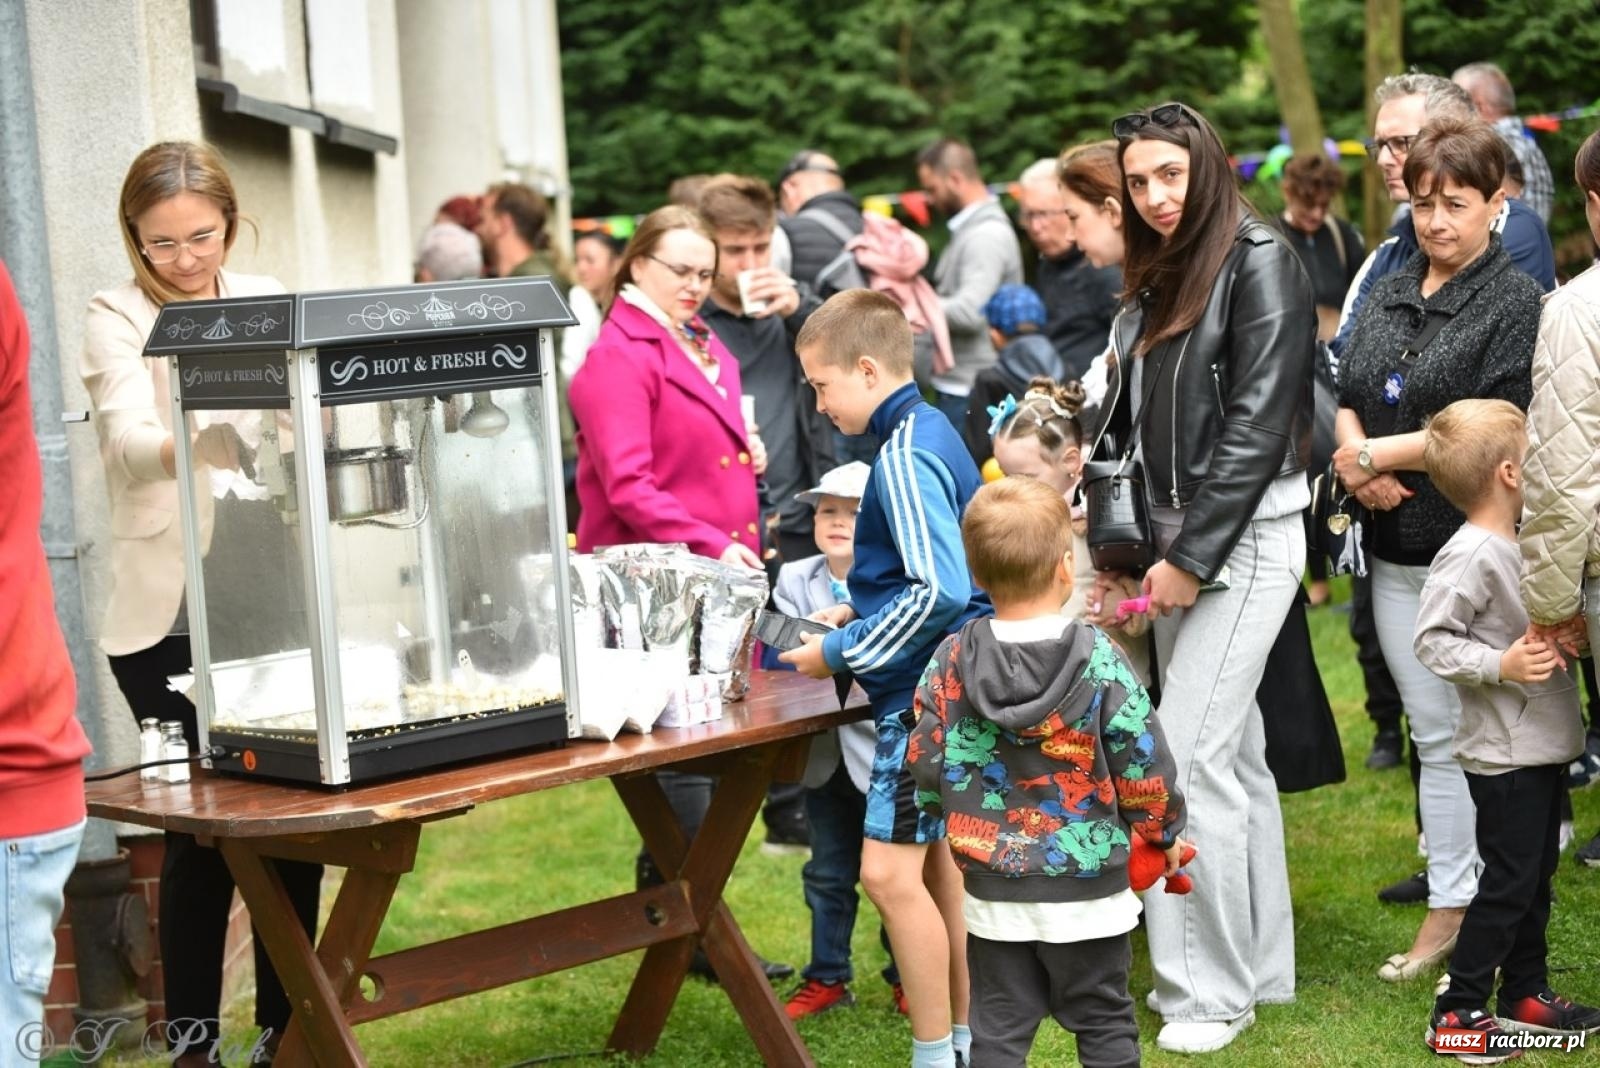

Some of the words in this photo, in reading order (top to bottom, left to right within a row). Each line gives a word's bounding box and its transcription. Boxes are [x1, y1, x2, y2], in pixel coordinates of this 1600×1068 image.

[373, 357, 410, 376] HOT
[414, 355, 428, 372] &
[431, 351, 487, 370] FRESH
[204, 371, 221, 383] HOT
[224, 371, 232, 382] &
[233, 369, 263, 382] FRESH
[1041, 741, 1095, 760] COMICS
[1116, 775, 1167, 797] MARVEL
[947, 812, 1000, 842] MARVEL
